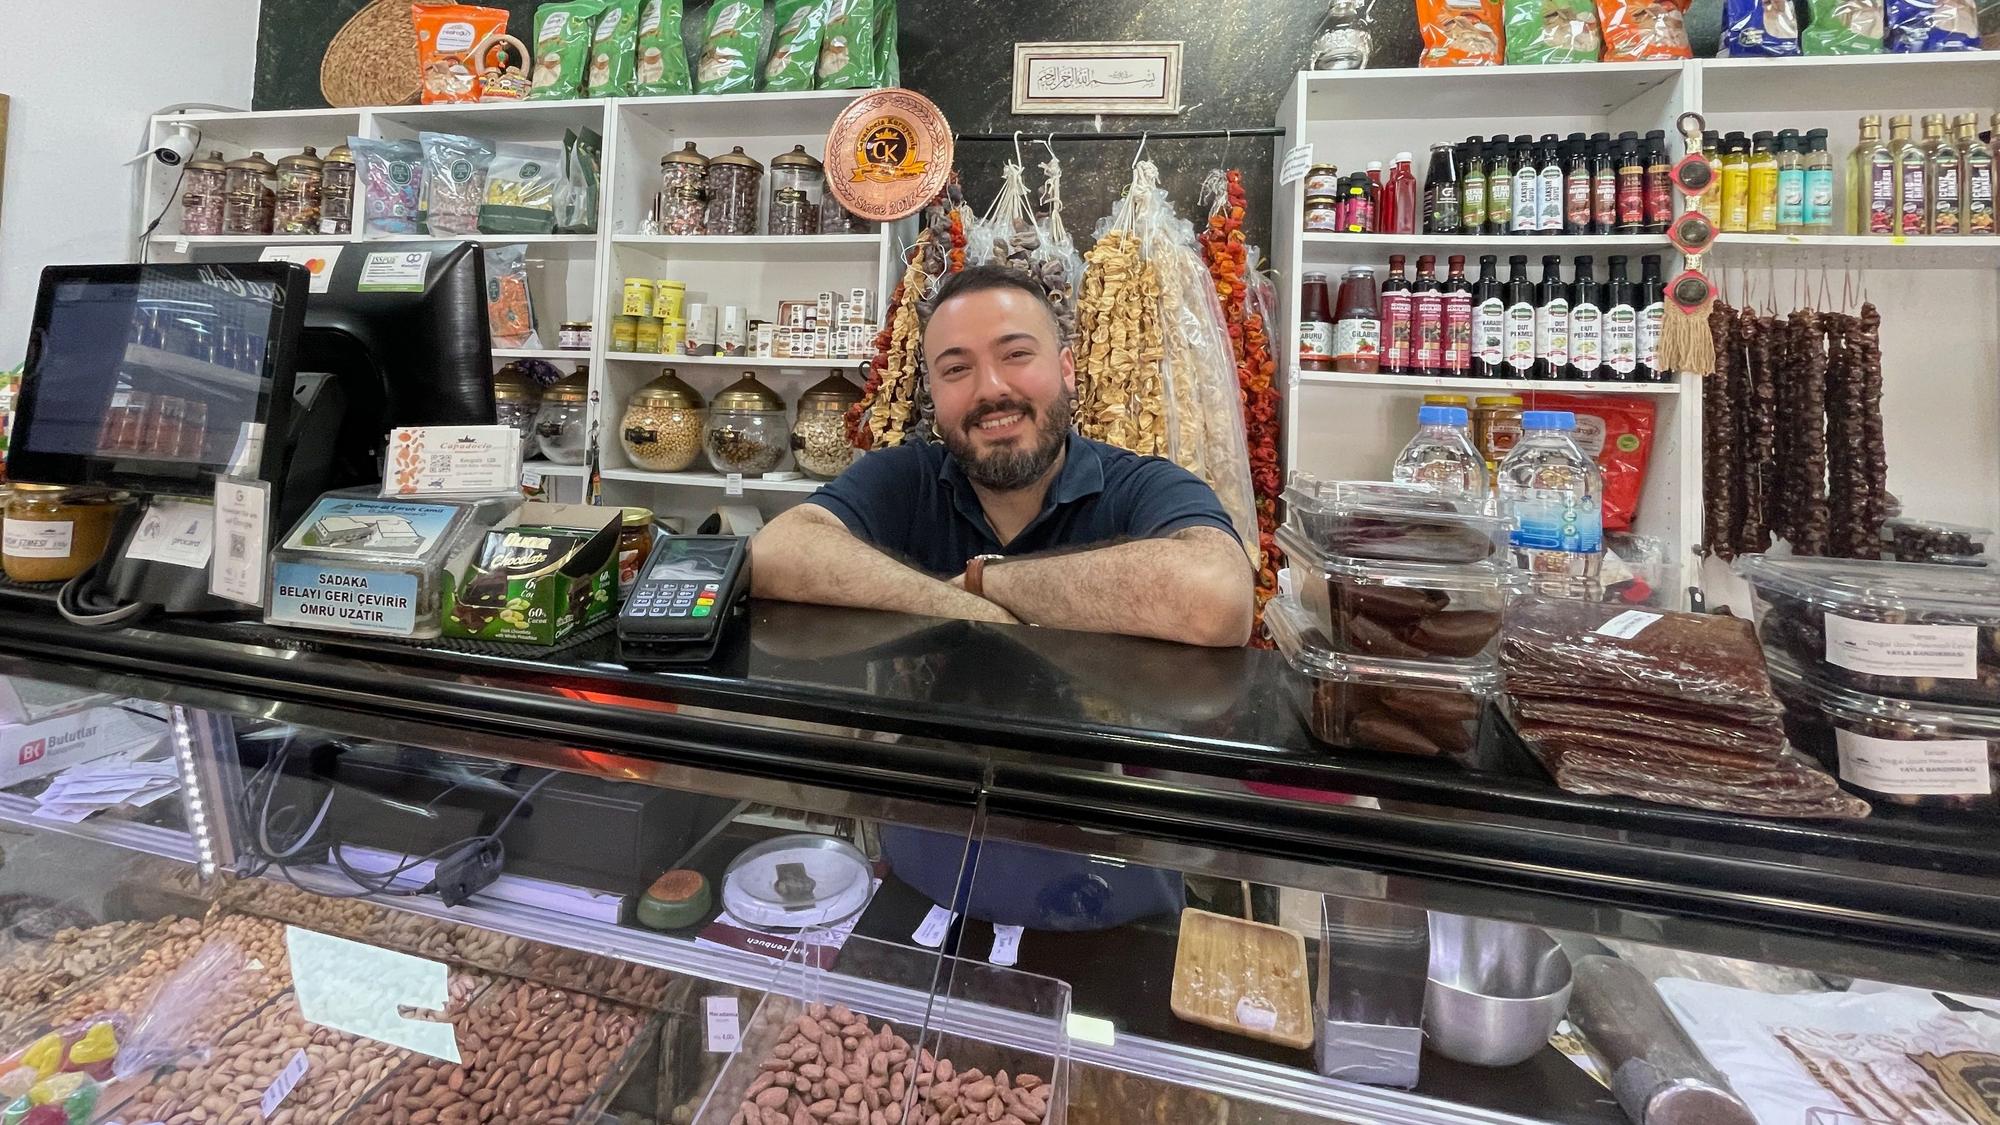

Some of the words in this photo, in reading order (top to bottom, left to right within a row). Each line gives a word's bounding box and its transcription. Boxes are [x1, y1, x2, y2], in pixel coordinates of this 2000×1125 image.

[873, 141, 898, 163] CK
[855, 195, 887, 216] Since
[889, 191, 918, 215] 2016
[491, 551, 548, 569] Chocolate
[319, 573, 368, 589] SADAKA
[279, 585, 321, 600] BELAYI
[324, 590, 353, 603] GERİ
[357, 593, 407, 609] ÇEVİRİR
[339, 607, 384, 622] UZATIR
[527, 617, 548, 625] Cocoa
[47, 726, 98, 748] Bulutlar
